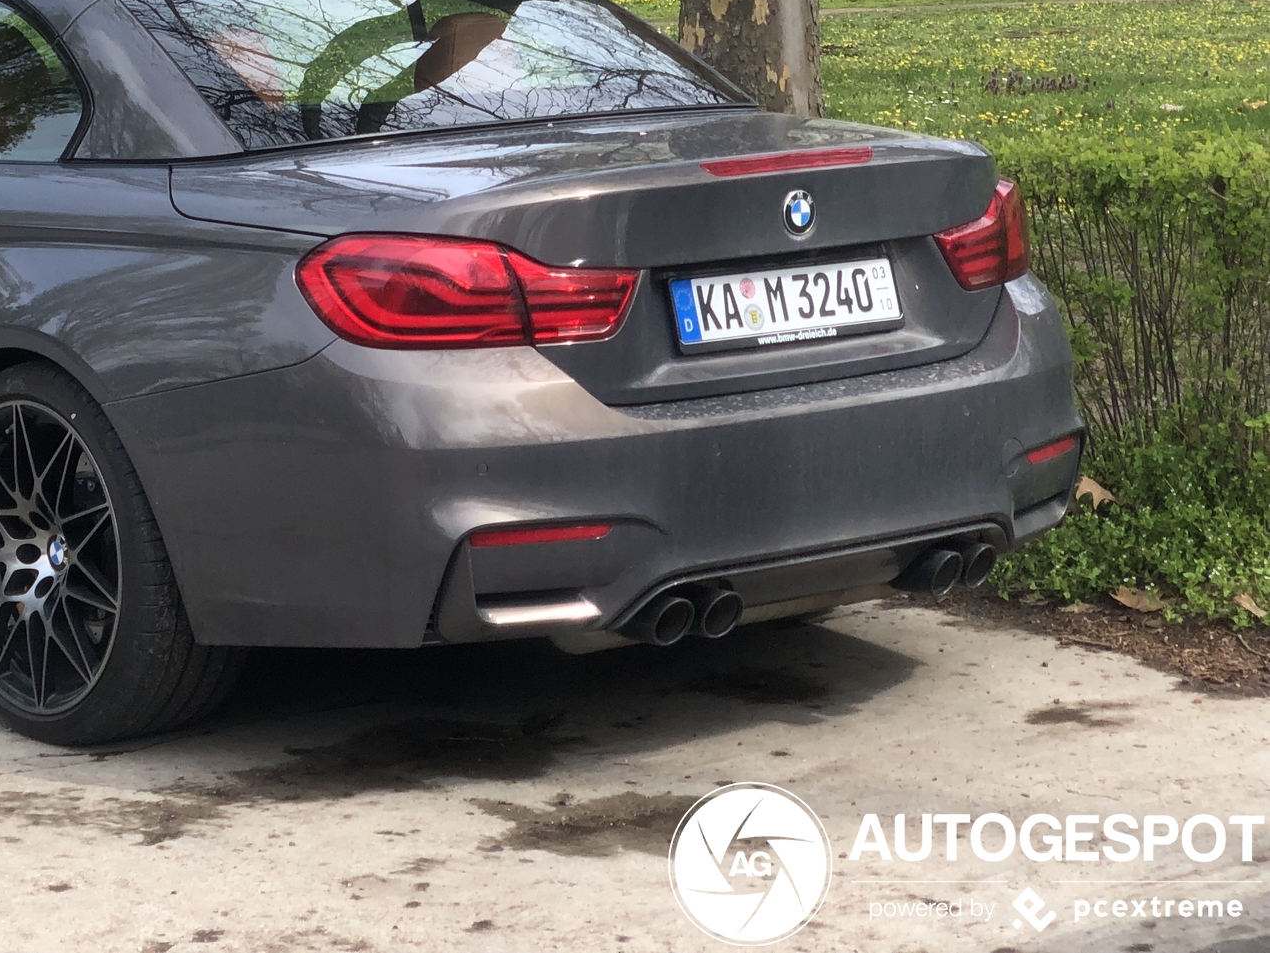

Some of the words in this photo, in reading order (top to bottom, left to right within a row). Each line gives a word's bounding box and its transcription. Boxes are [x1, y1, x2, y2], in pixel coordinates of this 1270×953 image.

[871, 265, 886, 280] 03
[696, 283, 744, 332] KA
[763, 276, 790, 323] M
[792, 268, 873, 319] 3240
[880, 297, 893, 311] 10
[684, 318, 694, 333] D
[757, 327, 838, 346] www.bmw-dreieich.de
